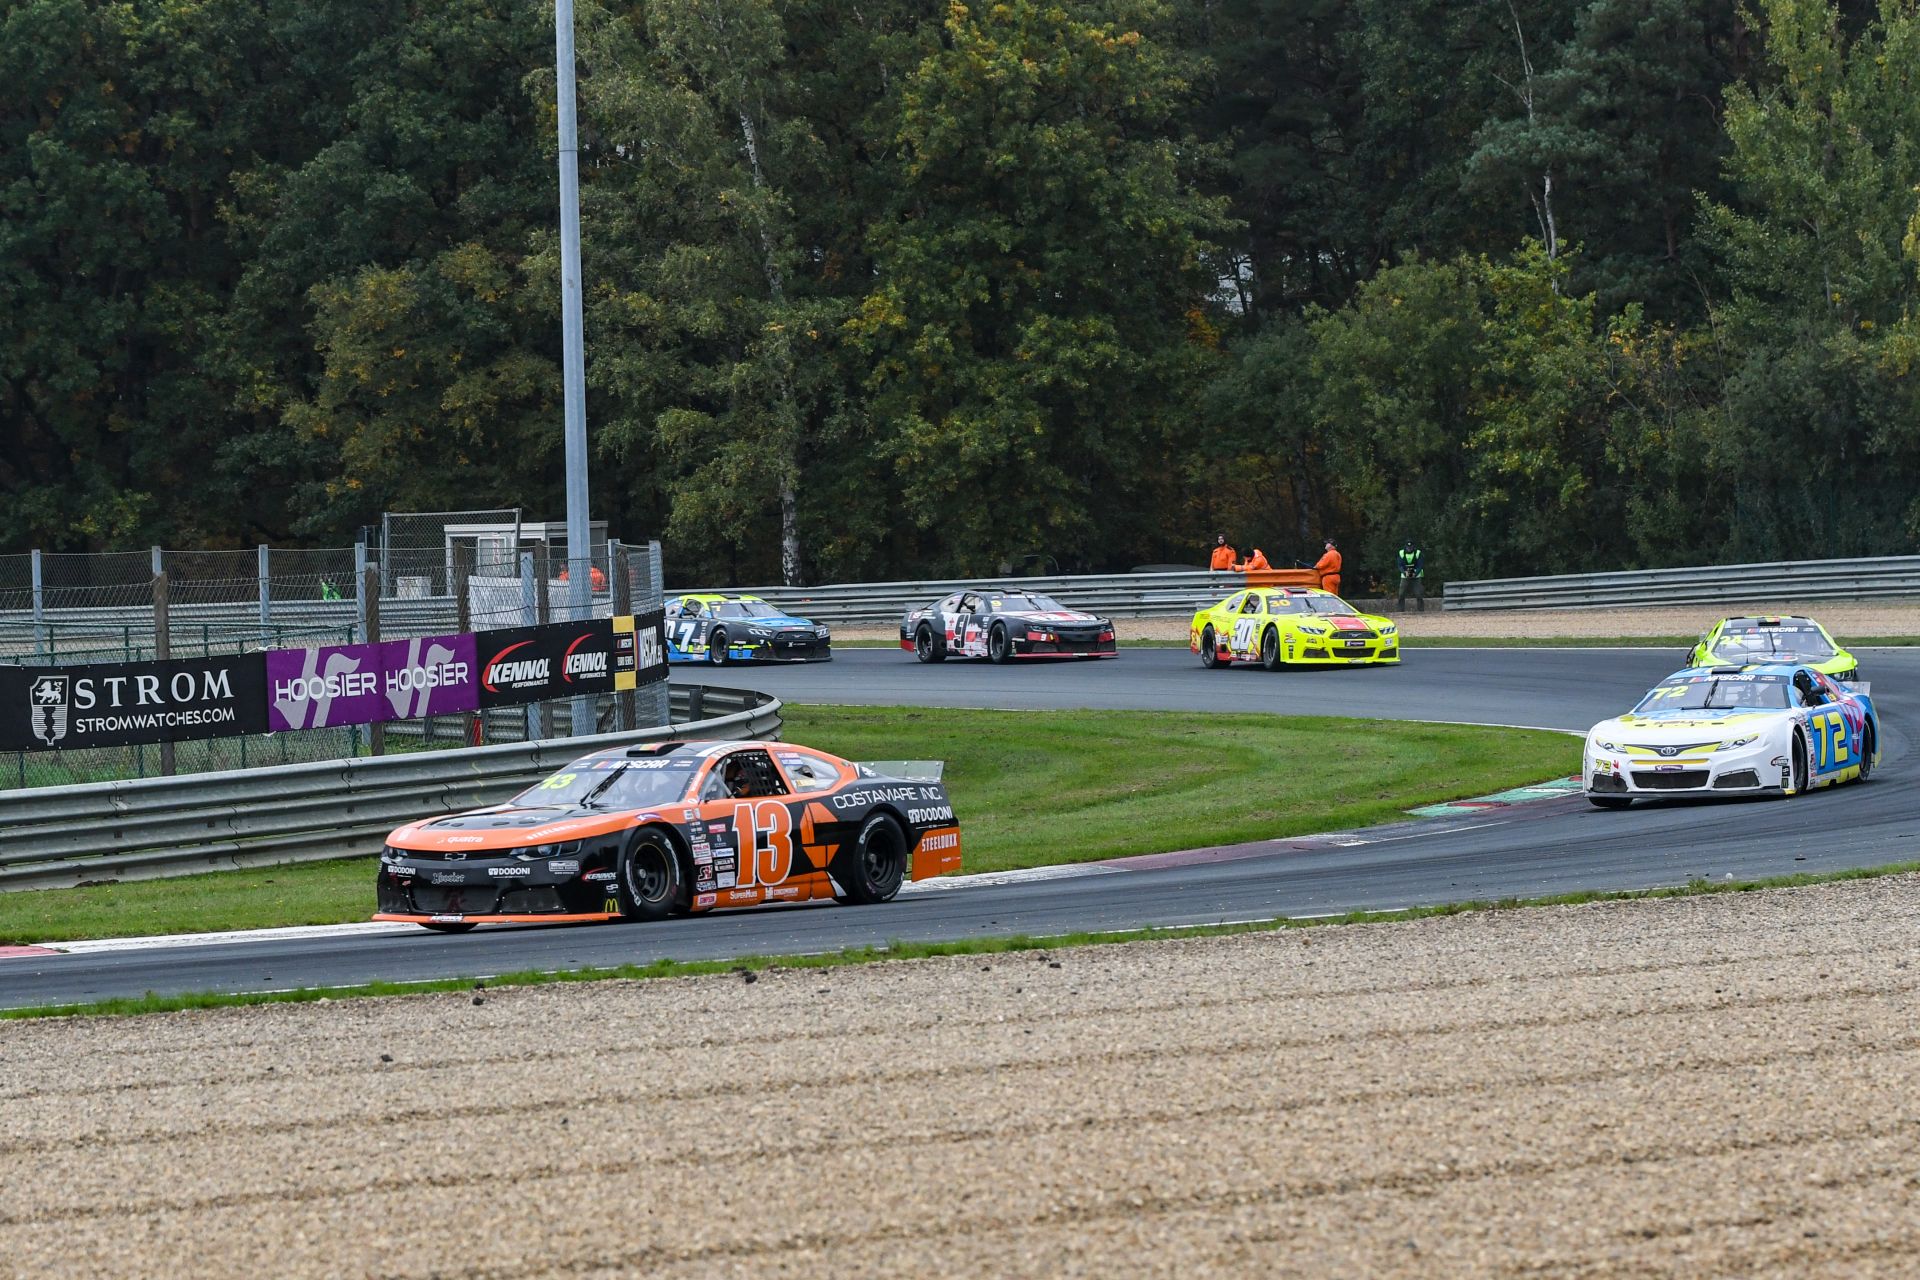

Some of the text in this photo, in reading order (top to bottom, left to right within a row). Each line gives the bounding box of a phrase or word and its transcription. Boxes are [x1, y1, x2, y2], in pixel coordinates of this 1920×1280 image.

[1269, 599, 1291, 608] 30
[678, 621, 697, 652] 7
[953, 613, 971, 649] 9
[1230, 617, 1256, 651] 30
[487, 658, 550, 685] KENNOL
[565, 652, 607, 675] KENNOL
[275, 671, 377, 702] HOOSIER
[385, 661, 469, 693] HOOSIER
[512, 680, 543, 689] PERFORMANCE
[1704, 674, 1756, 682] NASCAR
[74, 668, 235, 710] STROM
[1652, 685, 1689, 701] 72
[76, 707, 236, 733] STROMWATCHES.COM
[1811, 711, 1848, 767] 72
[1595, 759, 1612, 773] 72
[539, 773, 577, 790] 13
[832, 786, 943, 809] COSTAMARE INC.
[921, 805, 953, 824] DODONI
[448, 836, 484, 844] quatra
[731, 799, 793, 889] 13
[394, 866, 416, 875] DODONI
[431, 872, 465, 885] Hoosier
[499, 867, 531, 876] DODONI
[585, 872, 617, 880] KENNOL
